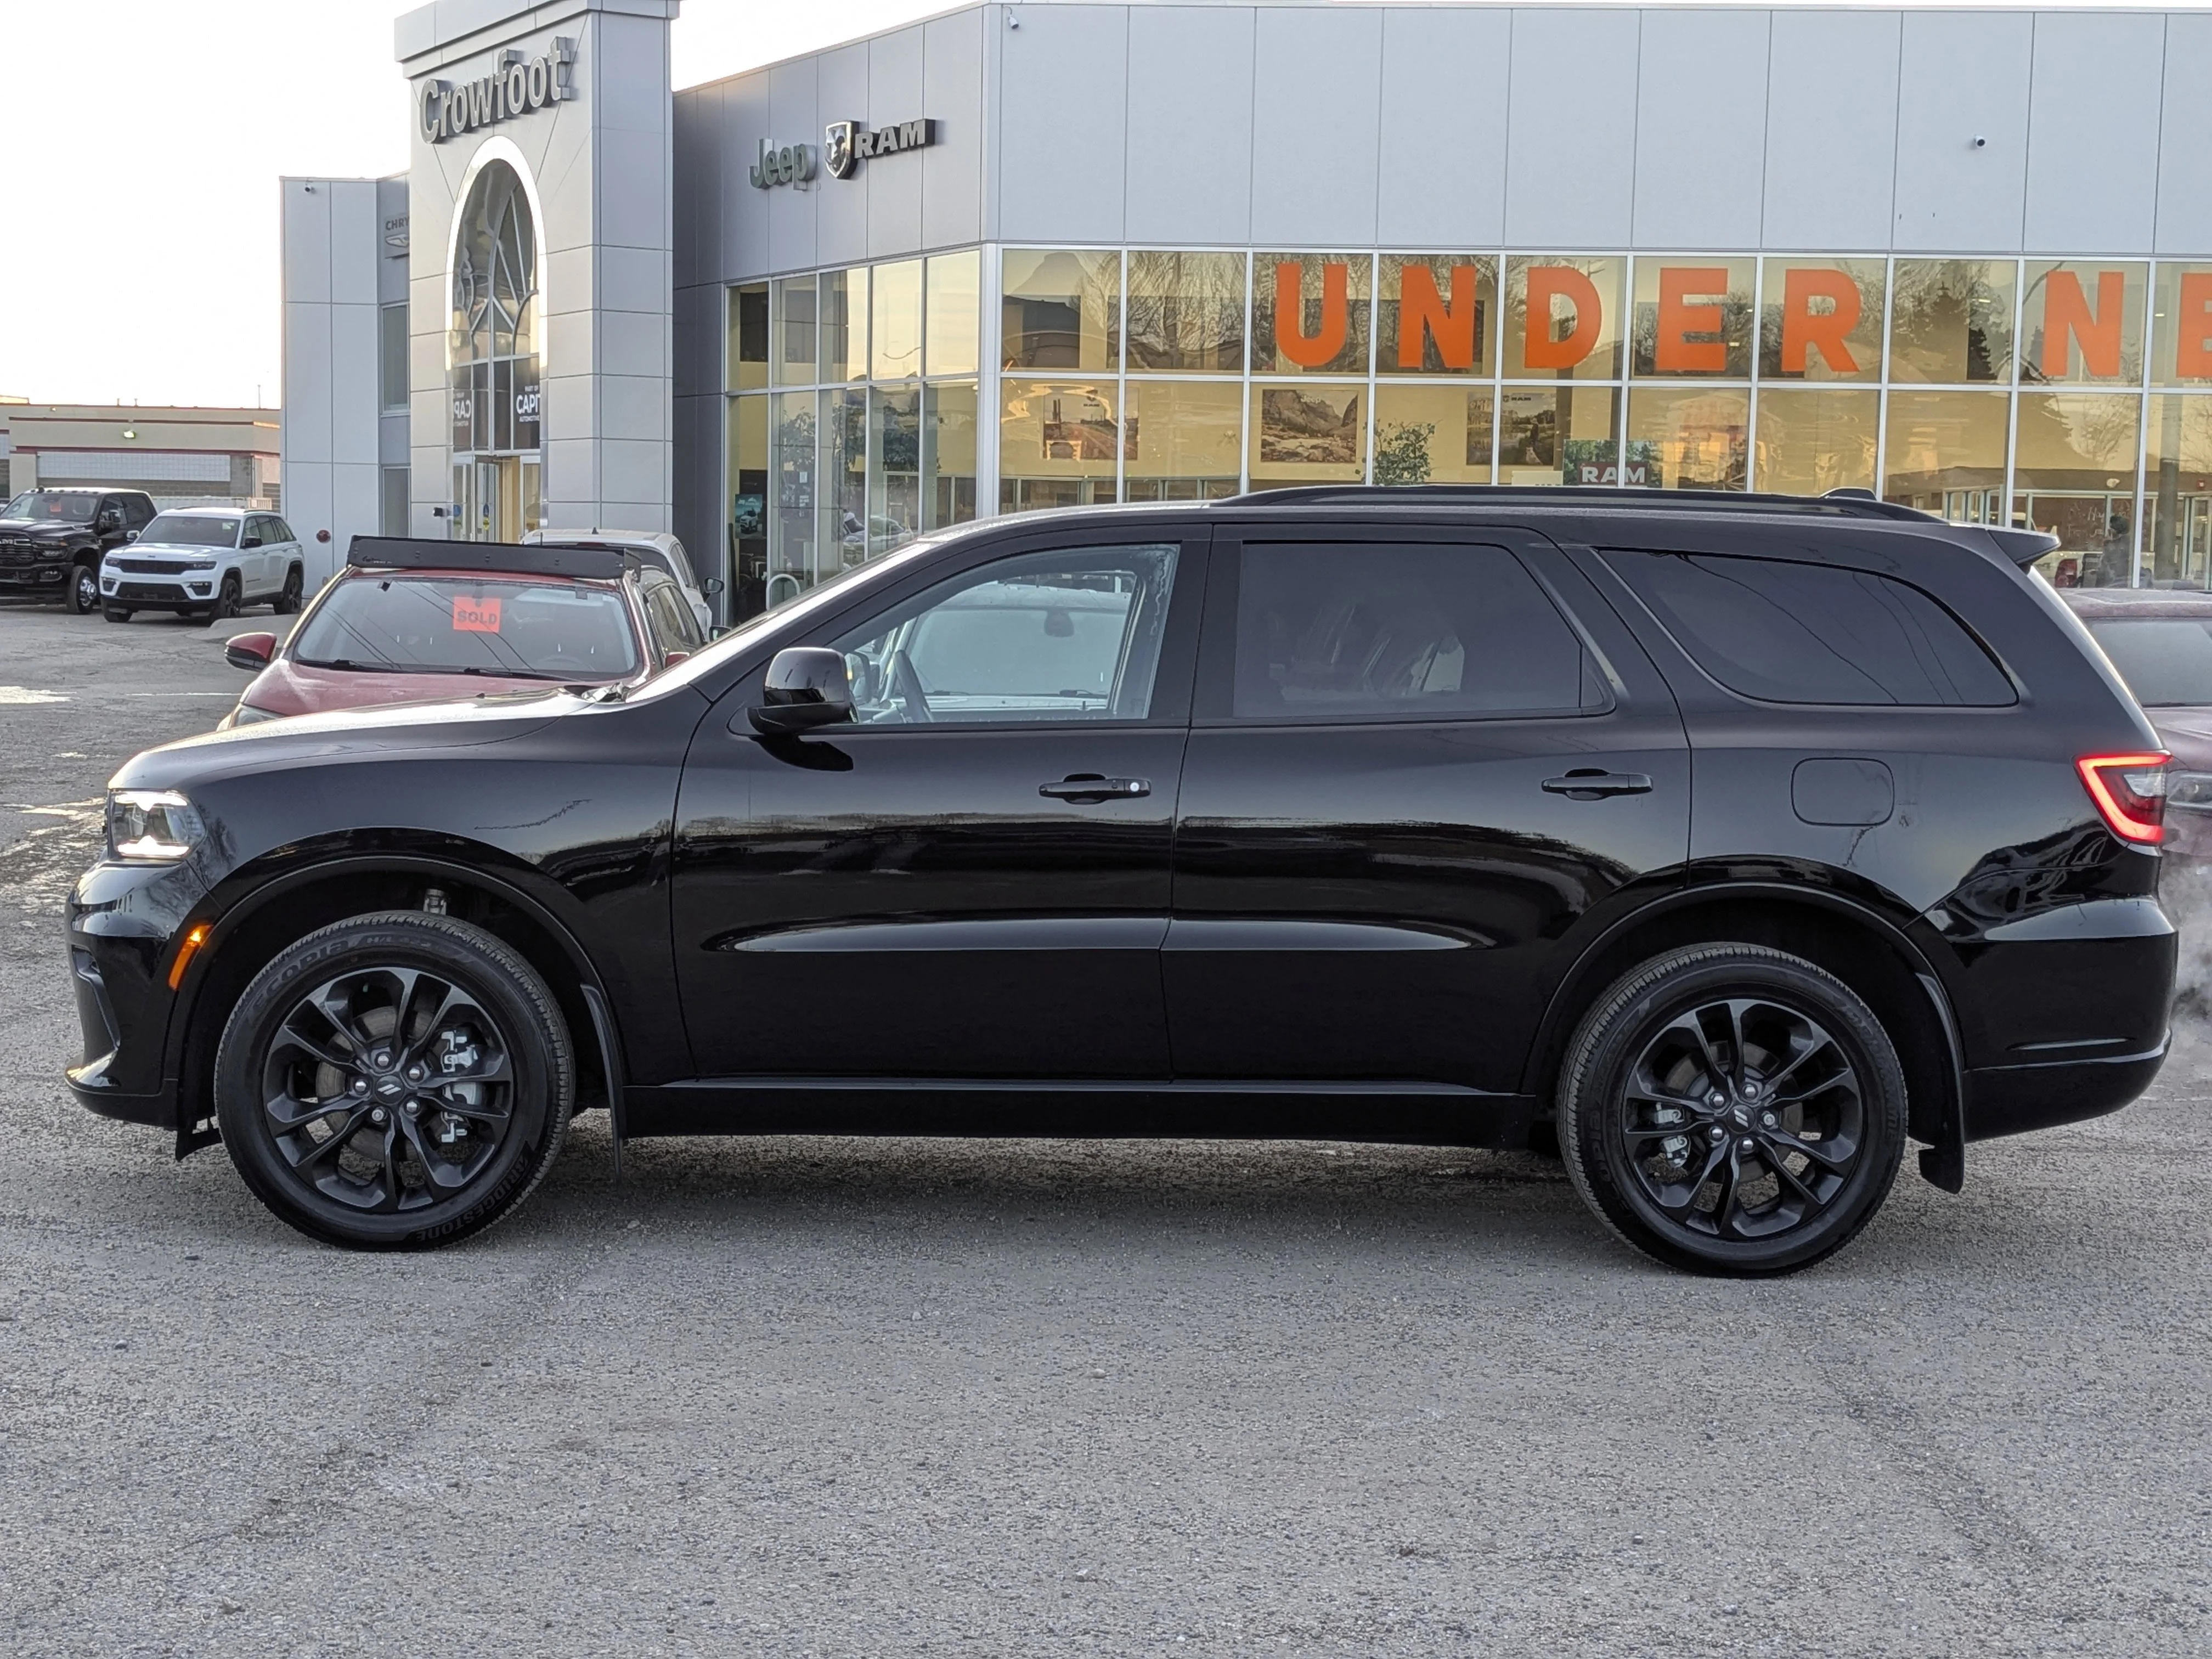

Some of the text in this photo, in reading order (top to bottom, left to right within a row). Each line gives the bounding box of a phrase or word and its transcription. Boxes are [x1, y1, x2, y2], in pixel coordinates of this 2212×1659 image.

[420, 36, 571, 144] Crowfoot
[854, 119, 935, 159] RAM
[748, 138, 815, 191] Jeep
[1275, 262, 1861, 372] UNDER
[1582, 466, 1645, 483] RAM
[457, 611, 497, 625] SOLD
